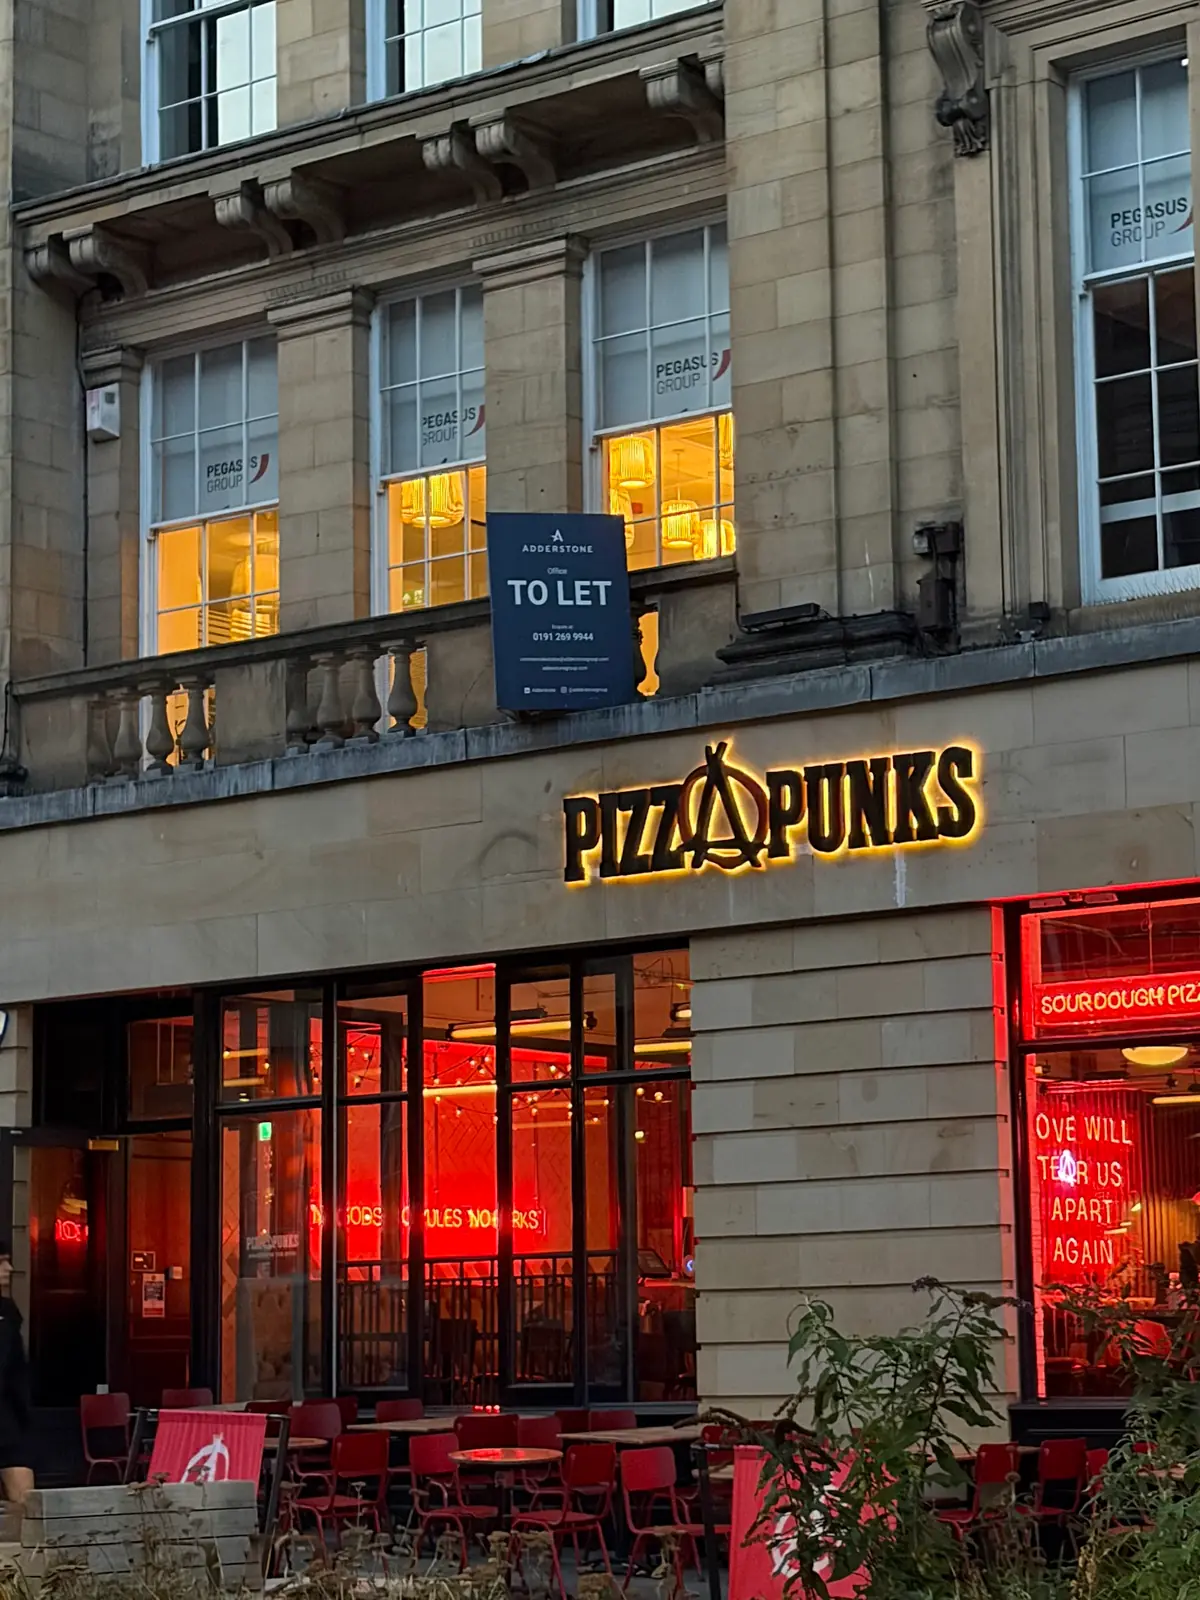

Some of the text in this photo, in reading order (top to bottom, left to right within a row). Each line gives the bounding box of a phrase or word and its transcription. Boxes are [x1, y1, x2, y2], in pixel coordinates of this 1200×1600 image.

[1111, 197, 1188, 229] PEGASUS
[1111, 221, 1166, 247] GROUP
[656, 373, 701, 395] GROUP
[206, 456, 258, 479] PEGASS
[206, 474, 243, 493] GROUP
[522, 544, 594, 553] ADDERSTONE
[507, 580, 612, 606] TO LET
[532, 632, 594, 641] 0191 269 9944
[1041, 982, 1200, 1014] SOURDOUGH PIZ
[1036, 1112, 1133, 1145] OVE WILL
[1097, 1161, 1123, 1187] US
[423, 1208, 463, 1229] ULES
[1051, 1196, 1113, 1224] APART
[1053, 1236, 1114, 1265] AGAIN
